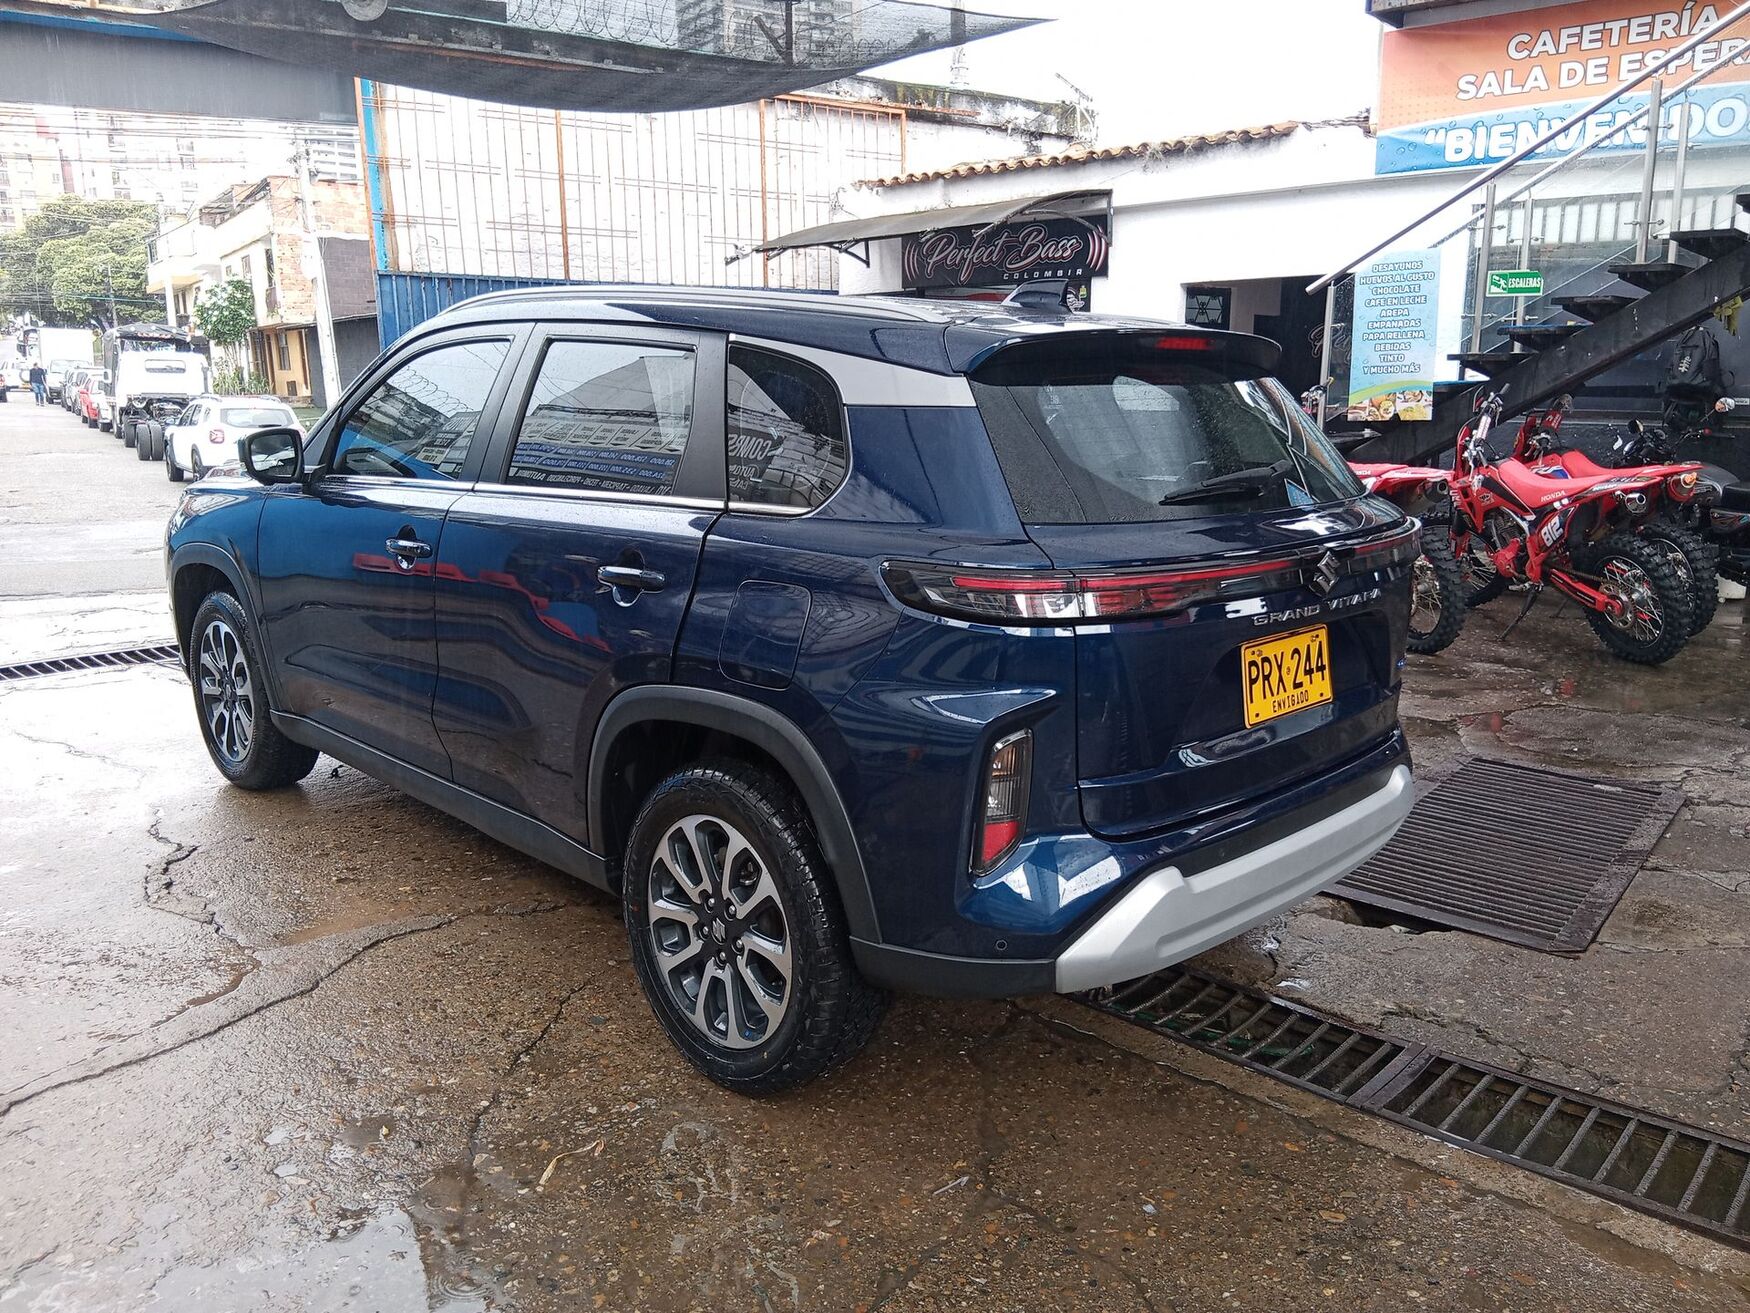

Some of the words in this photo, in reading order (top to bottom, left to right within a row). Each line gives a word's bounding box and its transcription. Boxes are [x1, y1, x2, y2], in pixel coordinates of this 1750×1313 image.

[1508, 1, 1720, 60] CAFETERÍA
[1456, 62, 1549, 100] SALA
[1559, 56, 1610, 88] DE
[922, 230, 1012, 286] Perfect
[1004, 224, 1083, 273] Bass
[1372, 260, 1424, 273] DESAYUNOS
[1003, 268, 1083, 280] COLOMBIA
[1360, 274, 1394, 285] HUEVOS
[1394, 273, 1406, 282] AL
[1407, 271, 1435, 281] GUSTO
[1508, 277, 1542, 288] ESCALERAS
[1372, 284, 1421, 296] CHOCOLATE
[1365, 297, 1386, 307] CAFE
[1387, 296, 1400, 306] EN
[1400, 295, 1427, 305] LECHE
[1380, 308, 1409, 318] AREPA
[1367, 319, 1421, 330] EMPANADAS
[1362, 332, 1386, 341] PAPA
[1387, 330, 1425, 340] RELLENA
[1374, 342, 1411, 352] BEBIDAS
[1379, 353, 1405, 362] TINTO
[1363, 366, 1370, 374] Y
[1370, 364, 1401, 374] MUCHO
[1401, 362, 1421, 373] MÁS
[1540, 489, 1566, 502] HONDA
[1541, 515, 1563, 547] 812
[1252, 604, 1320, 626] GRAND
[1327, 589, 1381, 609] VITARA
[1247, 651, 1288, 704] PRX
[1290, 640, 1327, 690] 244
[1272, 689, 1309, 713] ENVIGADO
